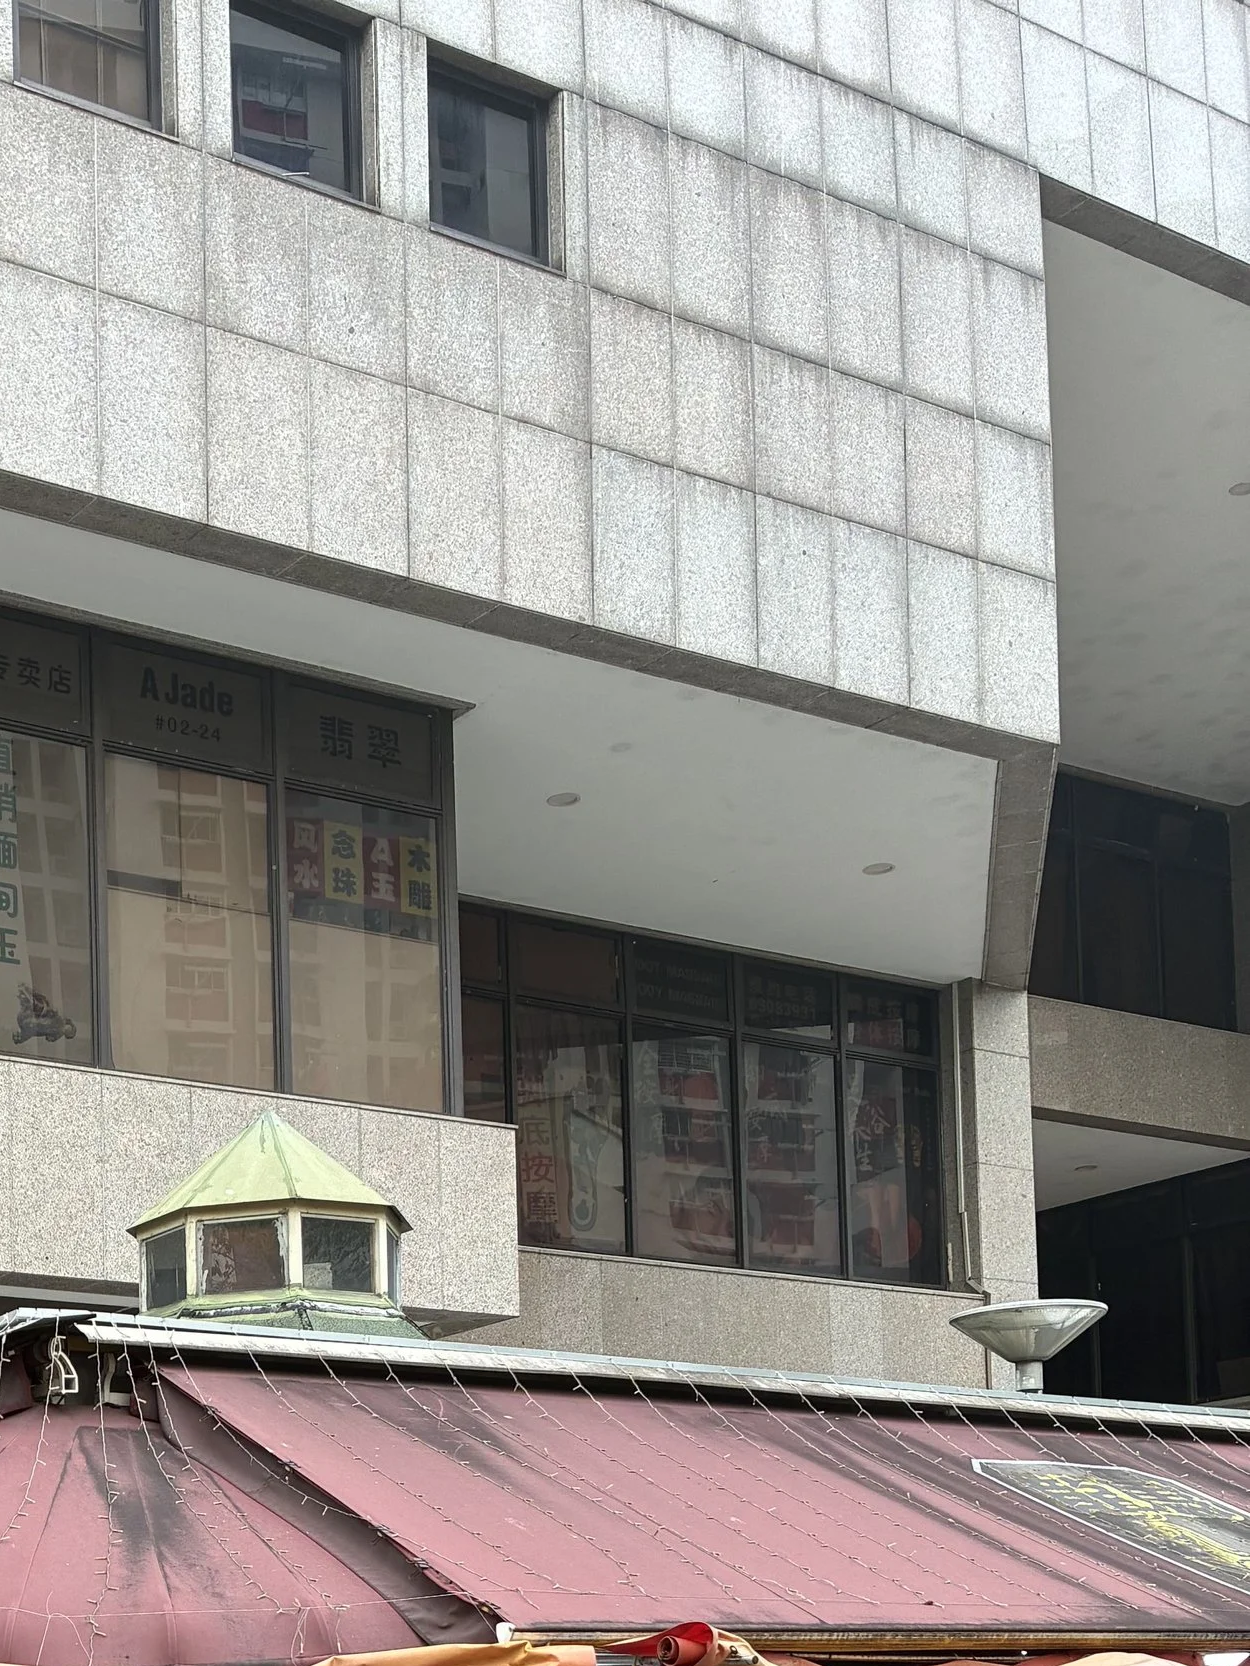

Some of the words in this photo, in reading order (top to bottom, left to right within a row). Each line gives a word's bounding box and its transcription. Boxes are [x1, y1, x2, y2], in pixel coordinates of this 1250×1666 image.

[140, 666, 161, 698] A
[164, 671, 235, 717] Jade
[155, 715, 222, 743] #02-24
[318, 713, 403, 769] 翡翠
[292, 821, 319, 891] 风水
[330, 828, 357, 898] 念珠
[407, 842, 432, 912] 木雕
